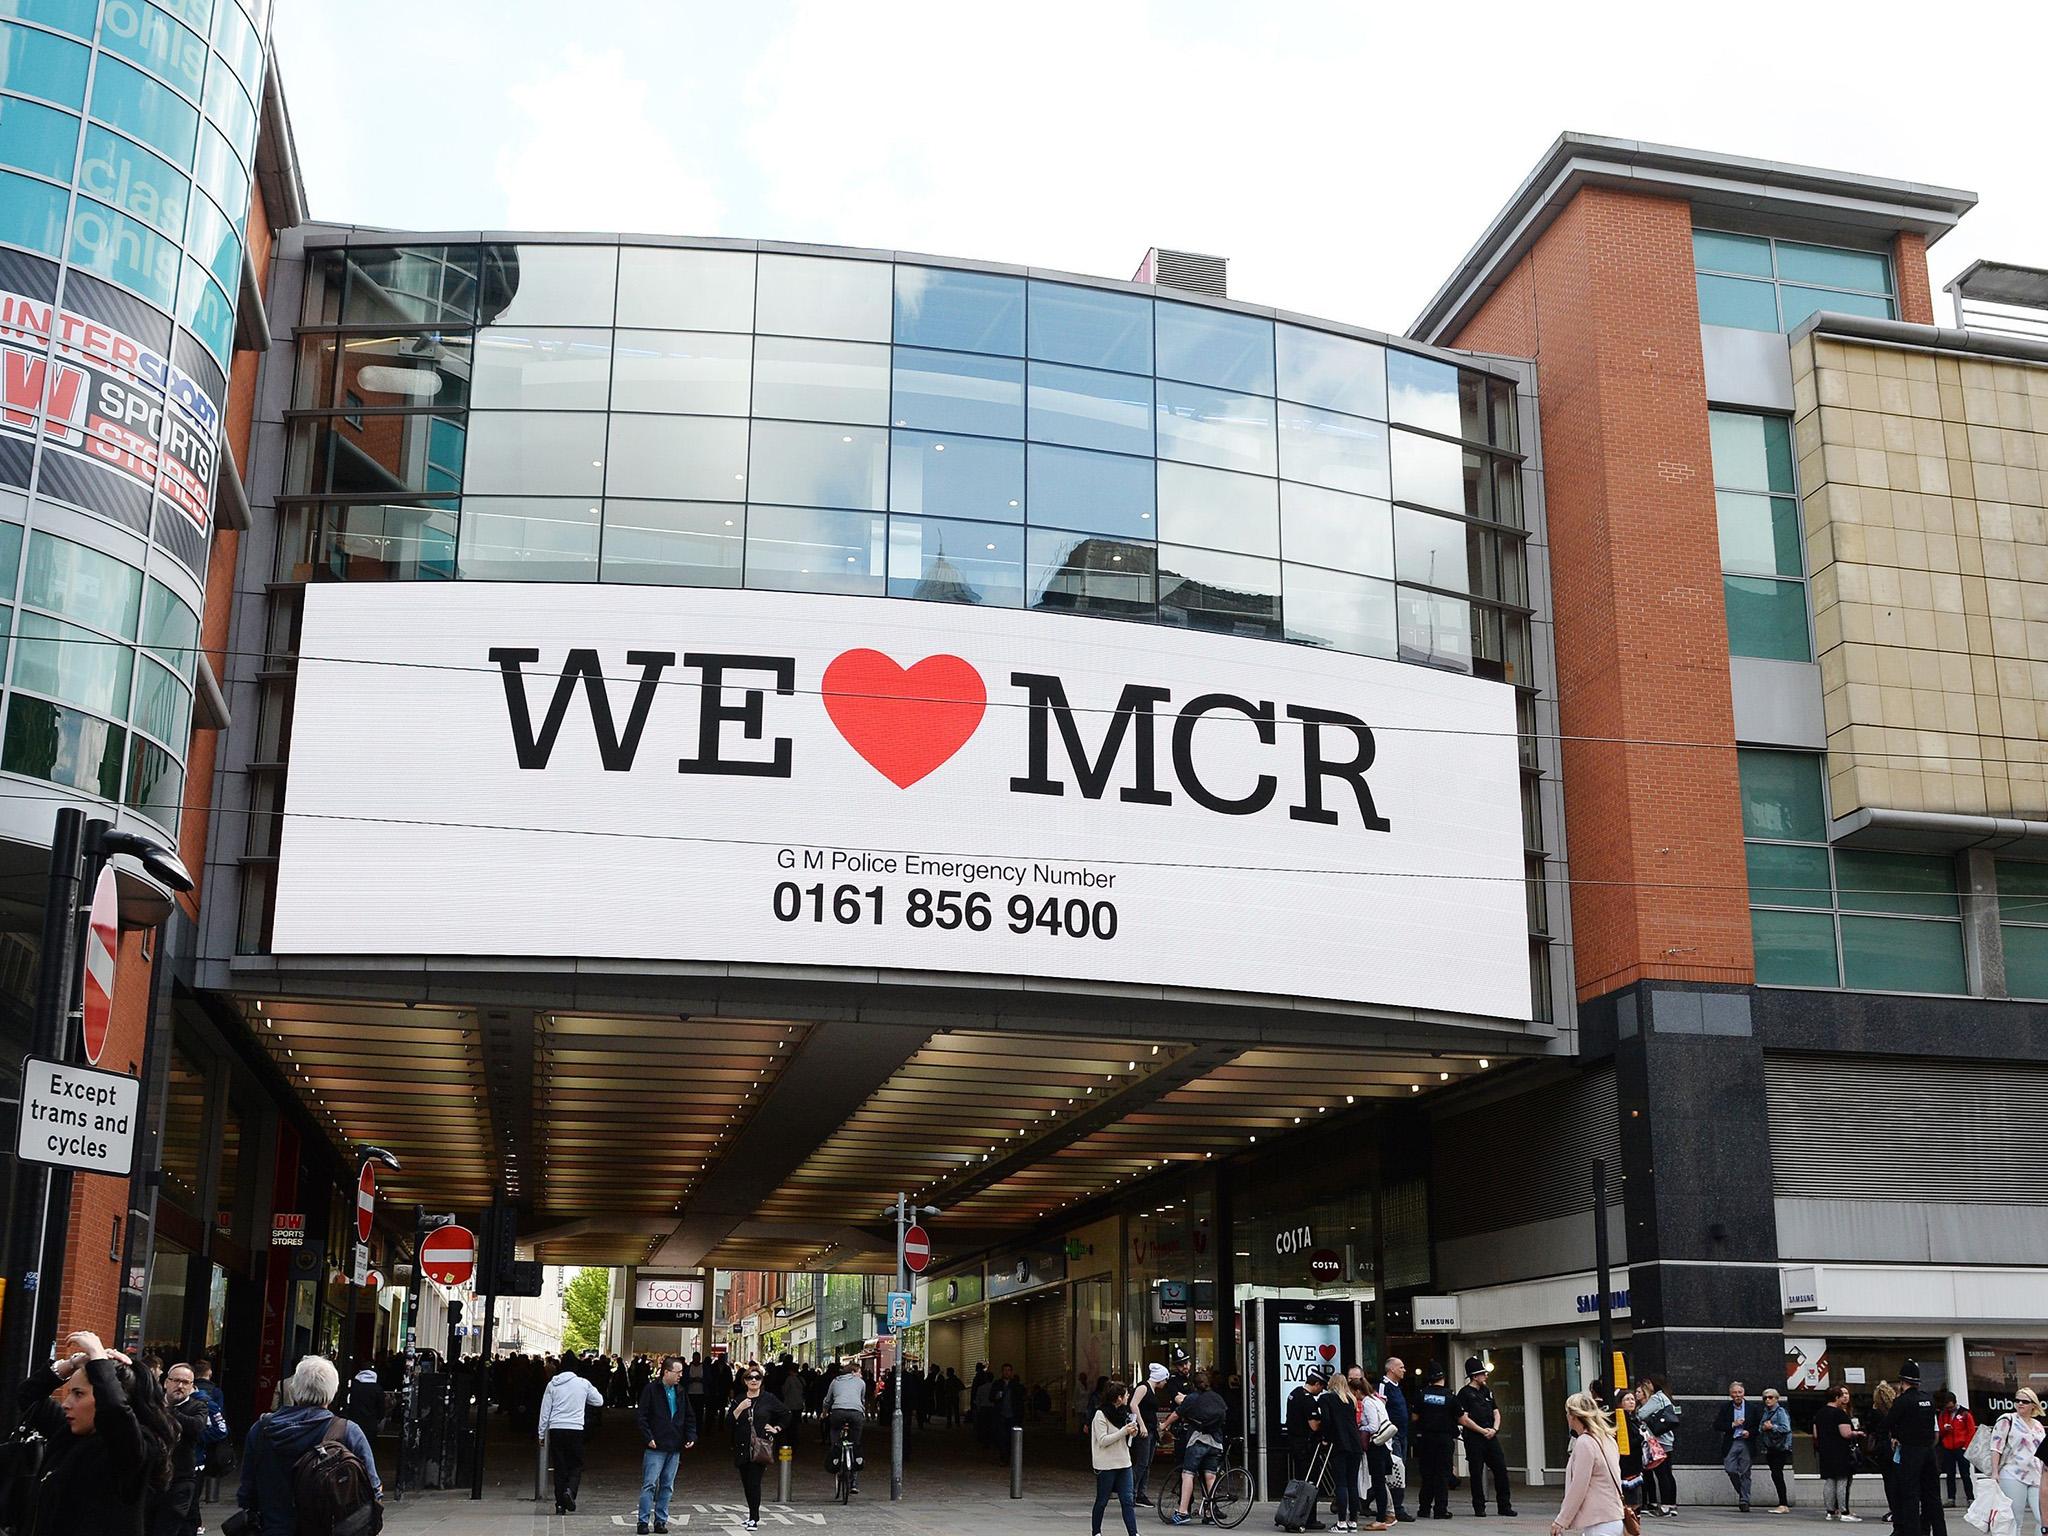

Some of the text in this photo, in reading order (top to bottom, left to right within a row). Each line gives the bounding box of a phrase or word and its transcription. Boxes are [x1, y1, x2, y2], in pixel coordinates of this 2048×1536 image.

[1, 297, 217, 440] INTERSPORT
[99, 382, 209, 483] SPORTS
[96, 422, 207, 517] STORES
[488, 647, 1391, 832] WE MCR
[777, 849, 1116, 888] G M Police Emergency Number
[773, 881, 1118, 940] 0161 856 9400
[50, 1074, 117, 1106] Except
[31, 1099, 129, 1135] trams and
[47, 1133, 107, 1159] cycles
[272, 1230, 305, 1238] SPORTS
[275, 1214, 303, 1229] DW
[271, 1237, 303, 1246] STORES
[1276, 1225, 1312, 1254] COSTA
[1312, 1261, 1339, 1270] COSTA
[648, 1282, 692, 1303] food
[1283, 1345, 1317, 1361] WE
[1988, 1398, 2017, 1410] Unb
